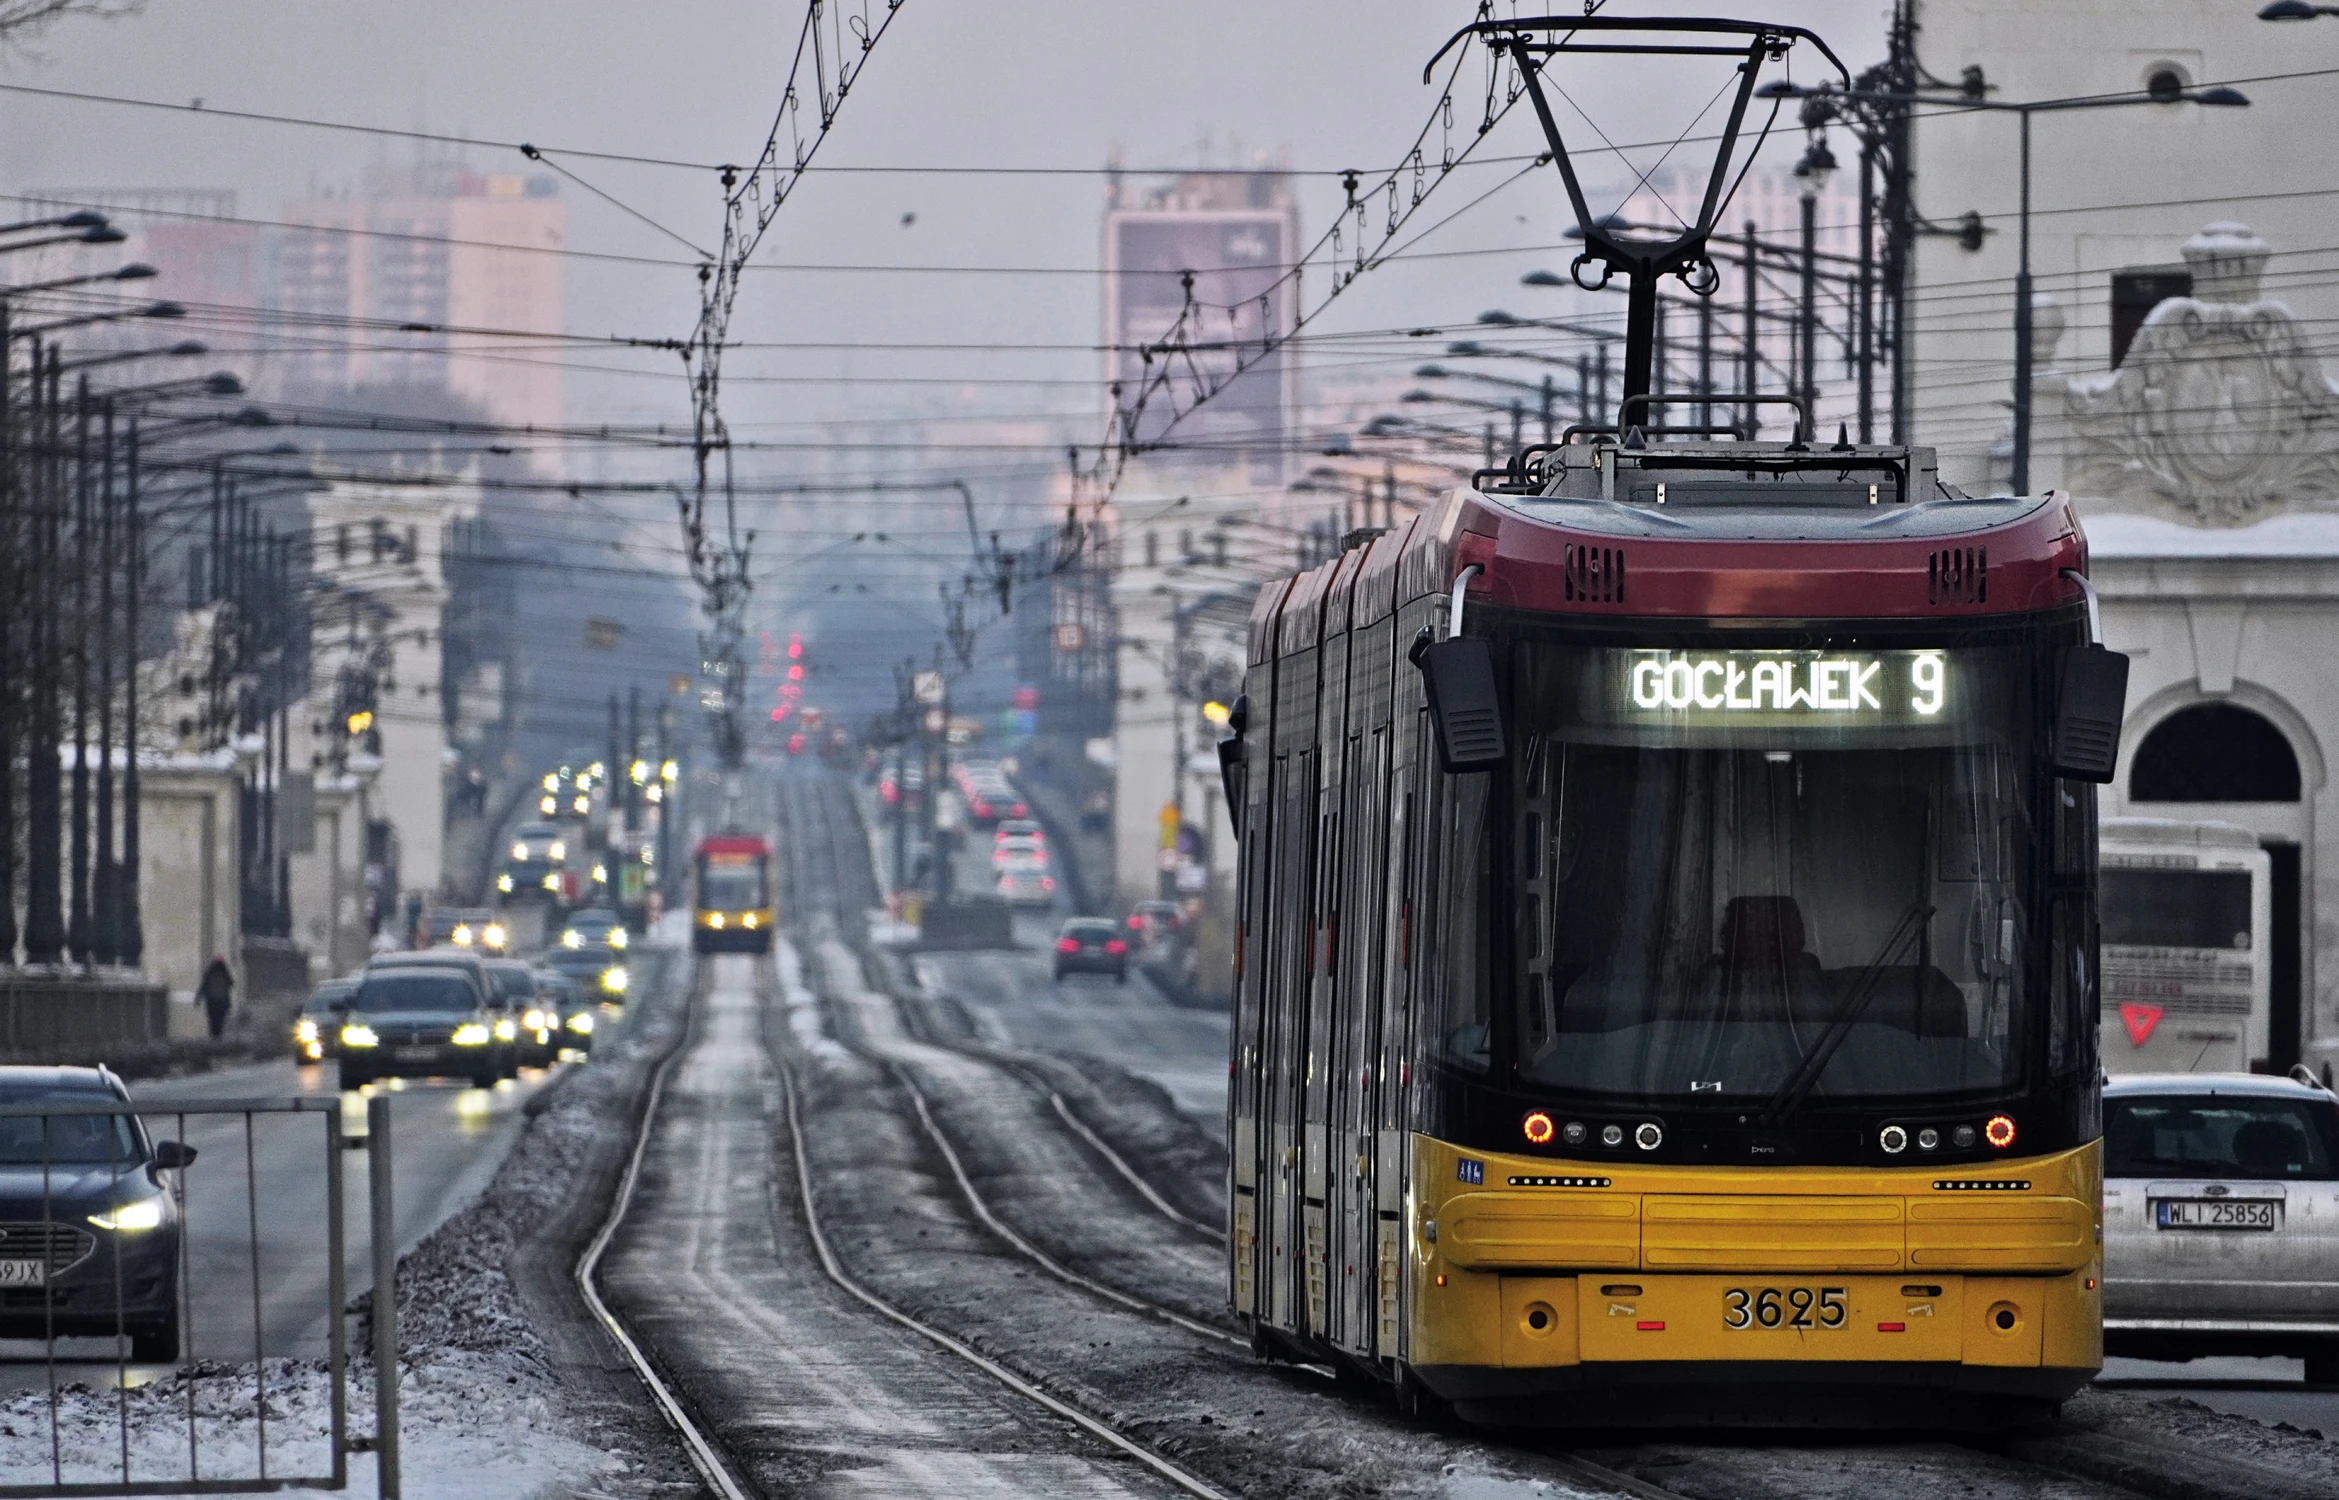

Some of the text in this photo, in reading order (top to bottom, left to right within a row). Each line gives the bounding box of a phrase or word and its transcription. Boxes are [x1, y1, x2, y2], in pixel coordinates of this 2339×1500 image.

[1632, 654, 1945, 715] GOCŁAWEK 9
[2211, 1203, 2270, 1224] 25856
[0, 1261, 38, 1281] 9JX
[1724, 1287, 1848, 1330] 3625
